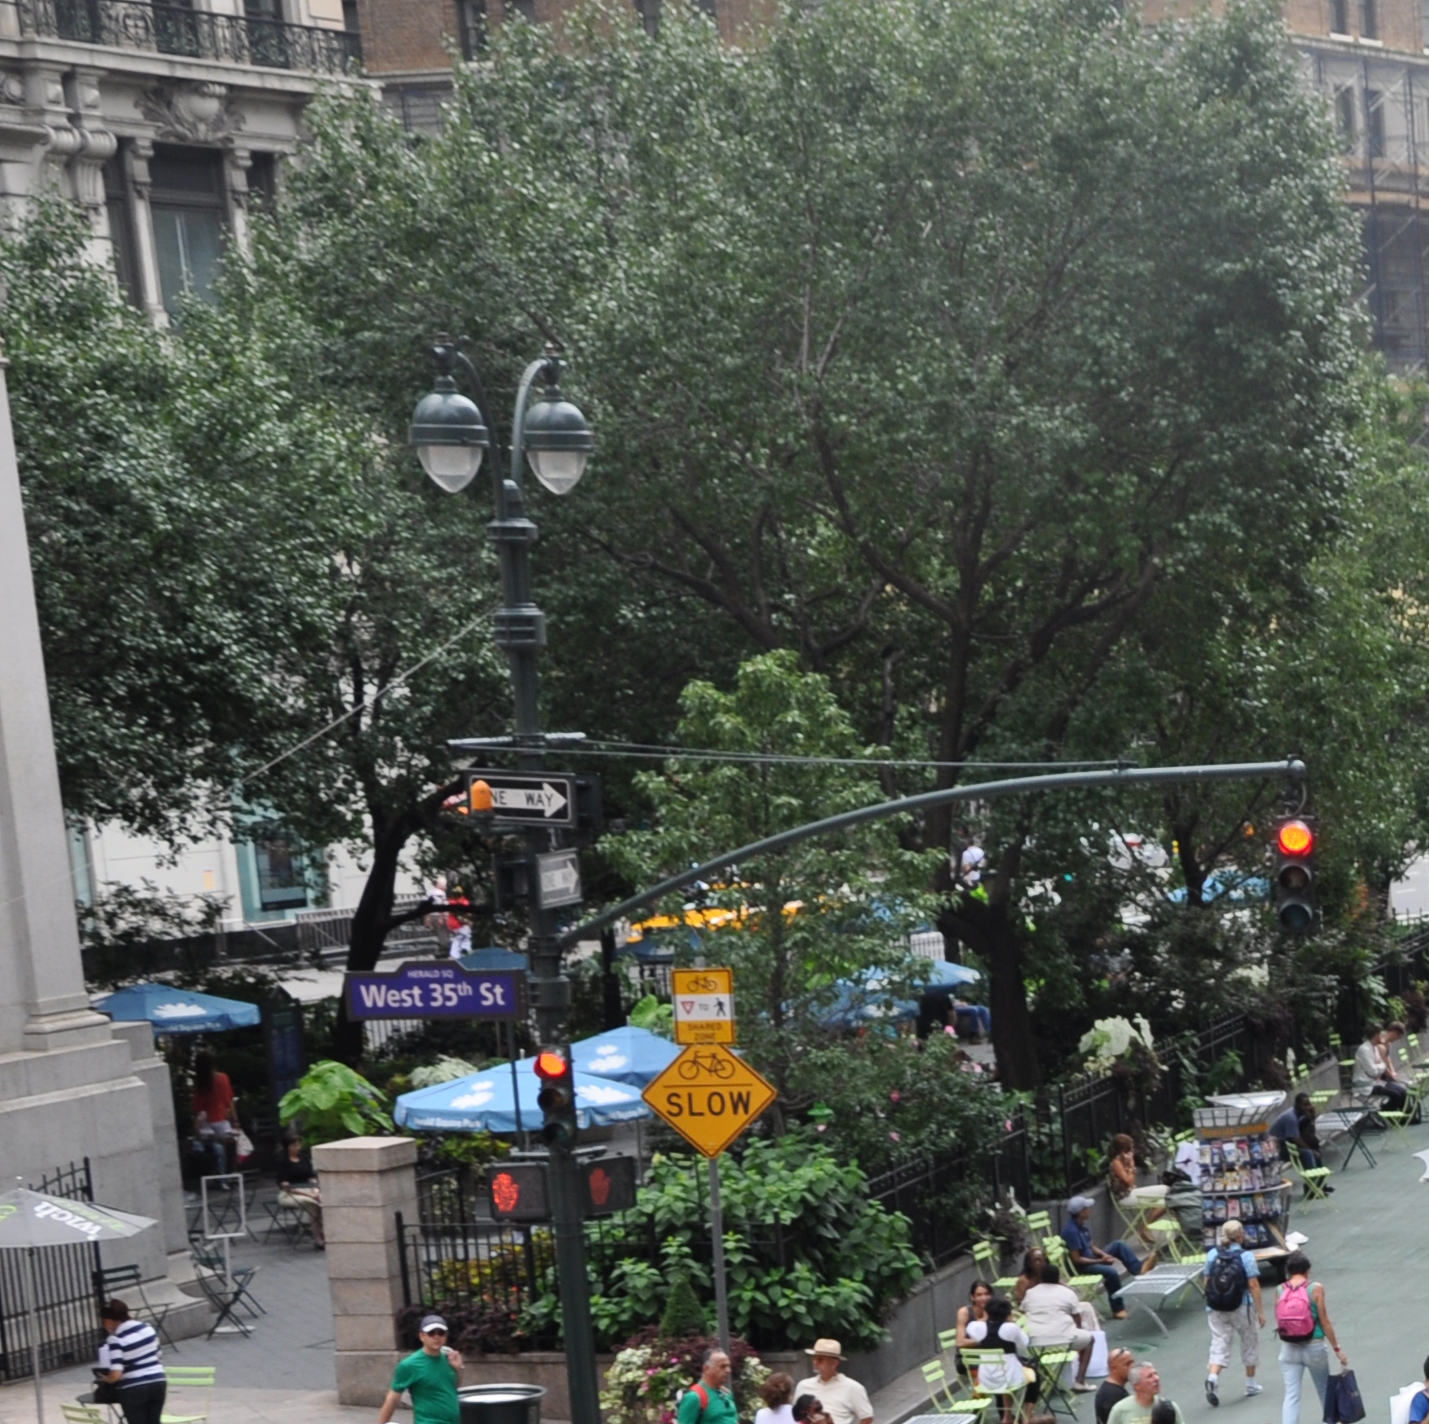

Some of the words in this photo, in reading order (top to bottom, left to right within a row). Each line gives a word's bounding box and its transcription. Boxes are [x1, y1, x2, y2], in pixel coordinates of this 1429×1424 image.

[524, 792, 554, 808] WAY
[407, 970, 440, 979] HERALD
[441, 969, 454, 980] SQ
[360, 984, 424, 1008] West
[428, 981, 473, 1007] 35th
[479, 982, 506, 1006] St
[687, 1023, 723, 1031] SHARED
[666, 1090, 751, 1117] SLOW
